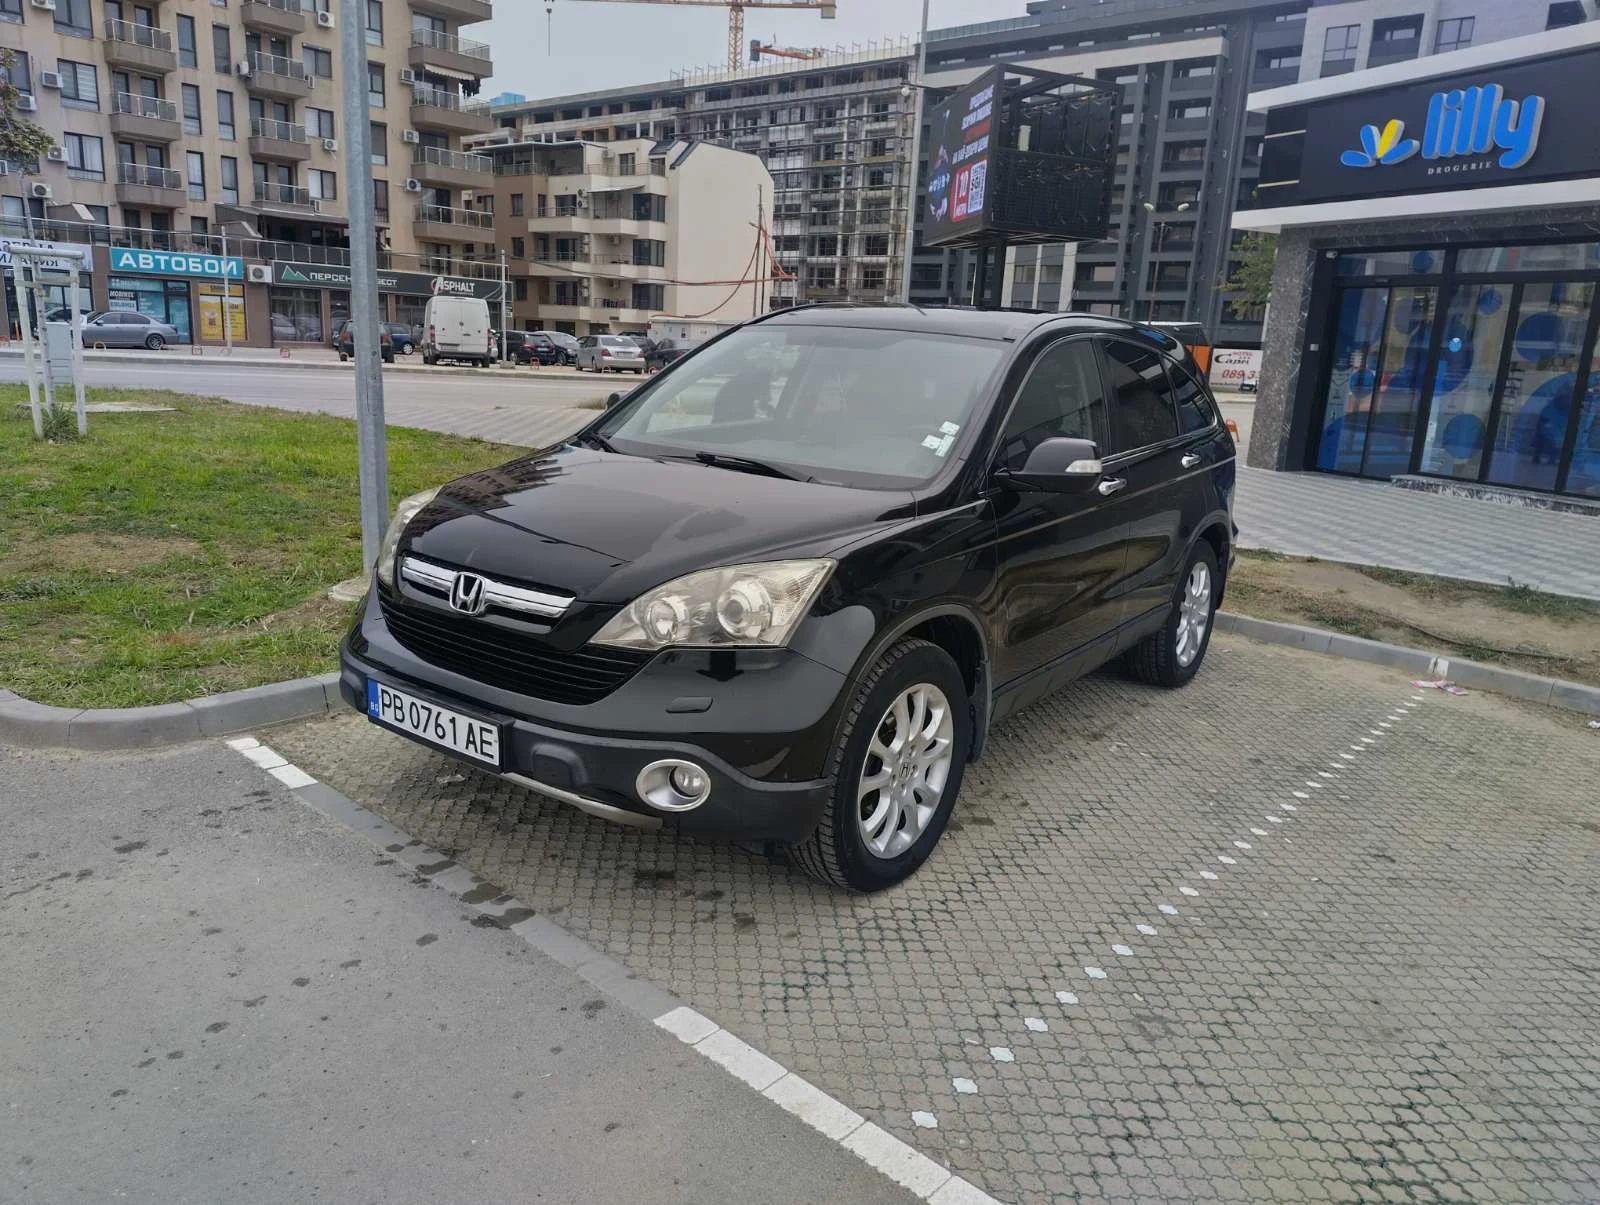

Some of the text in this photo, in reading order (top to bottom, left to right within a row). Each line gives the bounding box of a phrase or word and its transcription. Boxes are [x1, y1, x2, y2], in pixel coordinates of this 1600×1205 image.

[1421, 83, 1546, 169] lilly
[1427, 160, 1493, 175] DROGERIE
[119, 252, 237, 275] АВТОБОИ
[309, 272, 398, 287] ПЕРСЕН ВЕСТ
[380, 687, 495, 760] PB 0761 AE
